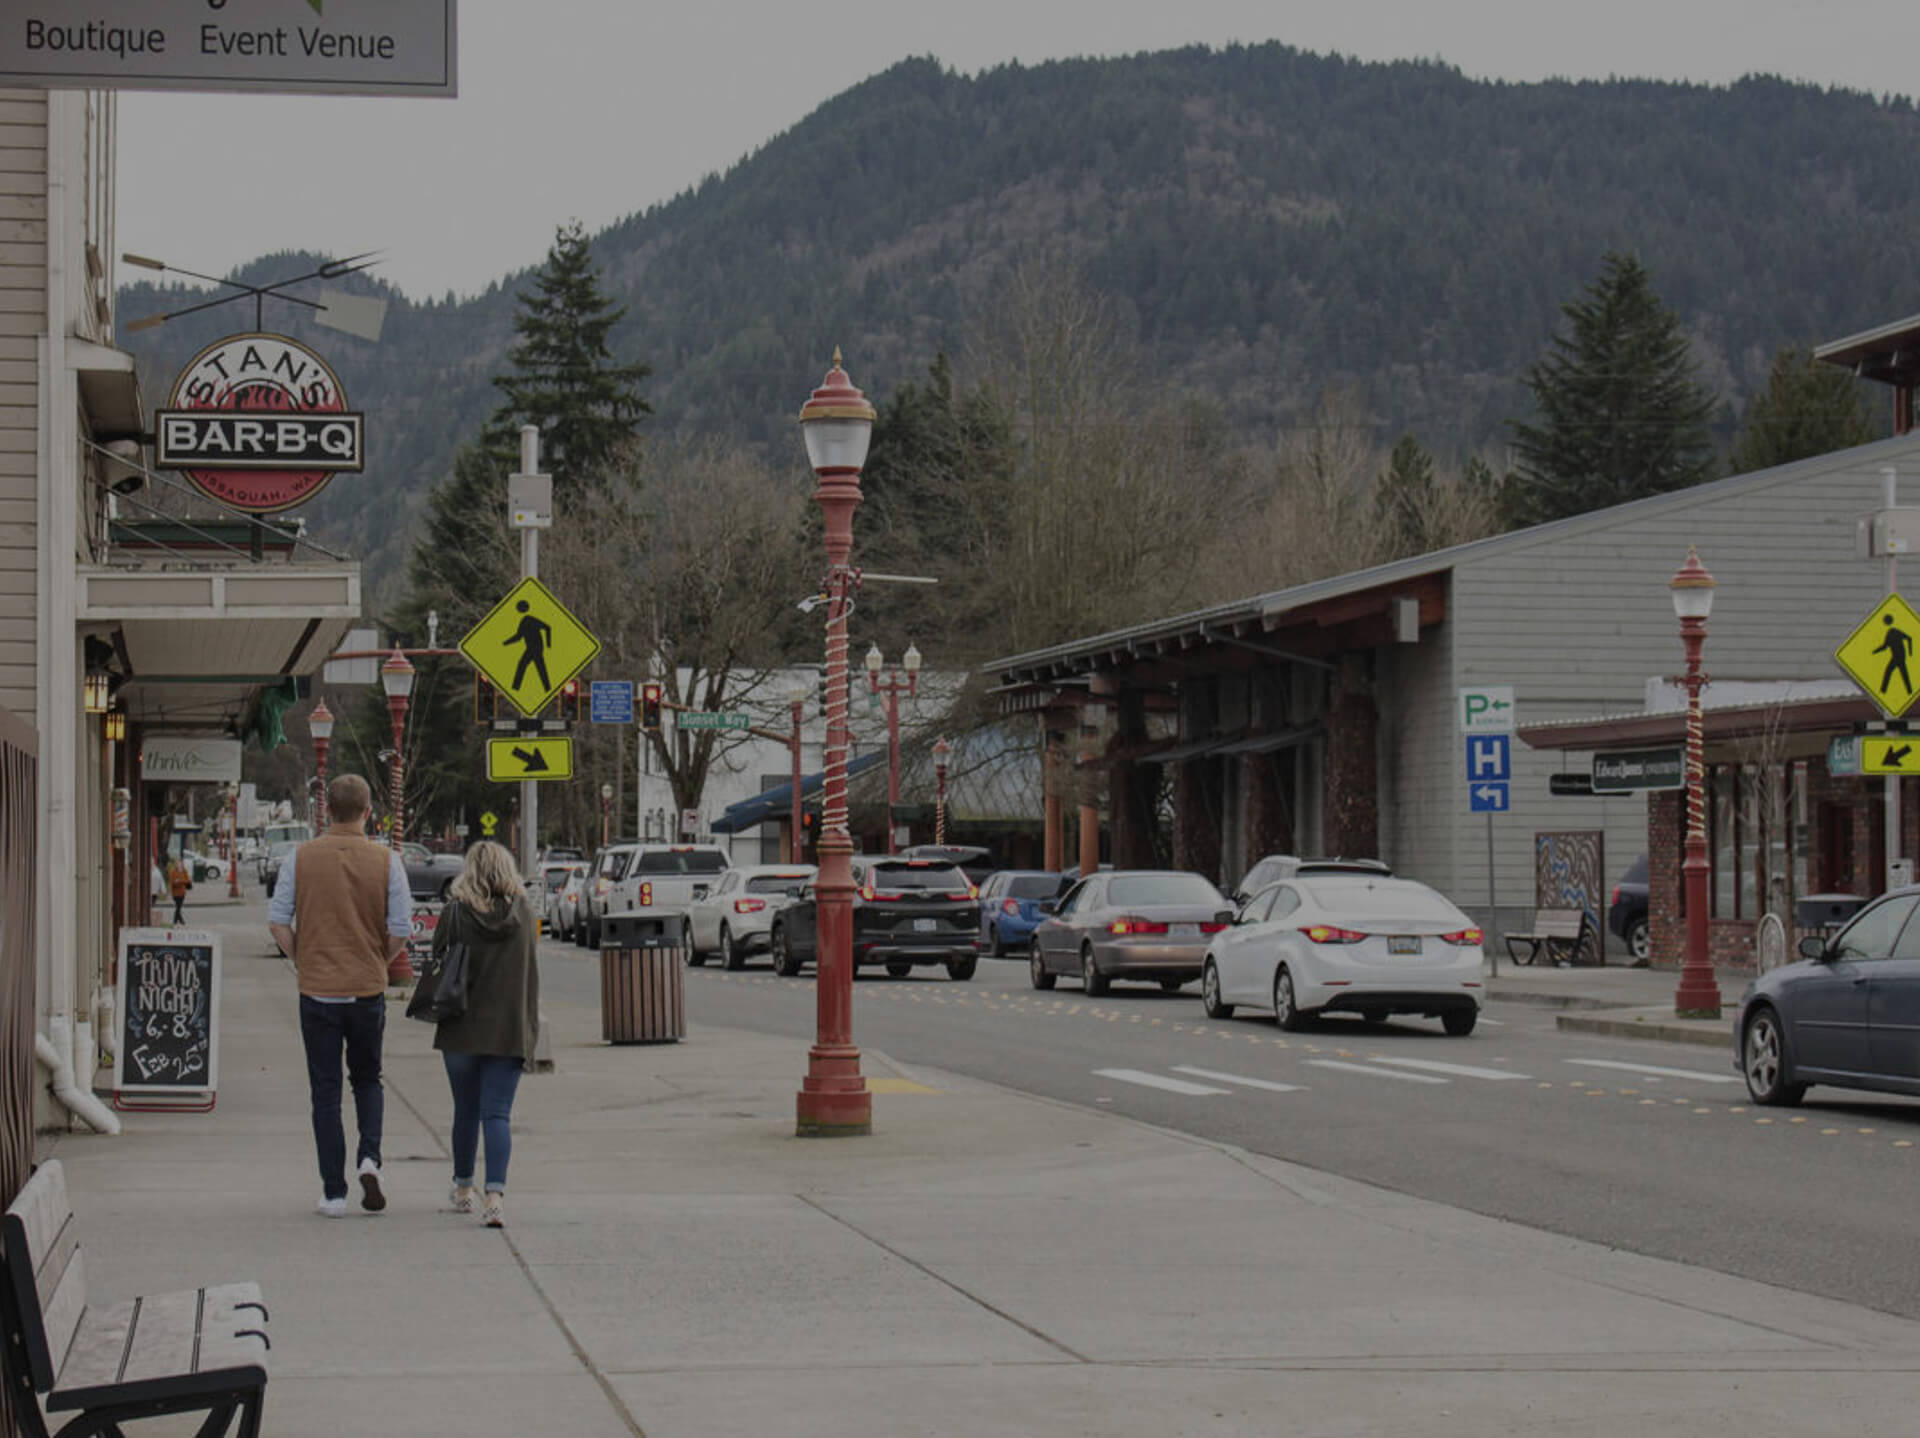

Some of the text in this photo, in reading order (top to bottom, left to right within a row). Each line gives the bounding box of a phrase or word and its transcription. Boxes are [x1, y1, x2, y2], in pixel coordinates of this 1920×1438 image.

[26, 19, 396, 60] Boutique Event Venue
[186, 345, 329, 409] STAN'S
[166, 420, 353, 458] BAR-B-Q
[1465, 693, 1489, 726] P
[1474, 740, 1502, 776] H
[135, 952, 200, 991] TRIVIA
[138, 985, 195, 1016] NIGHT
